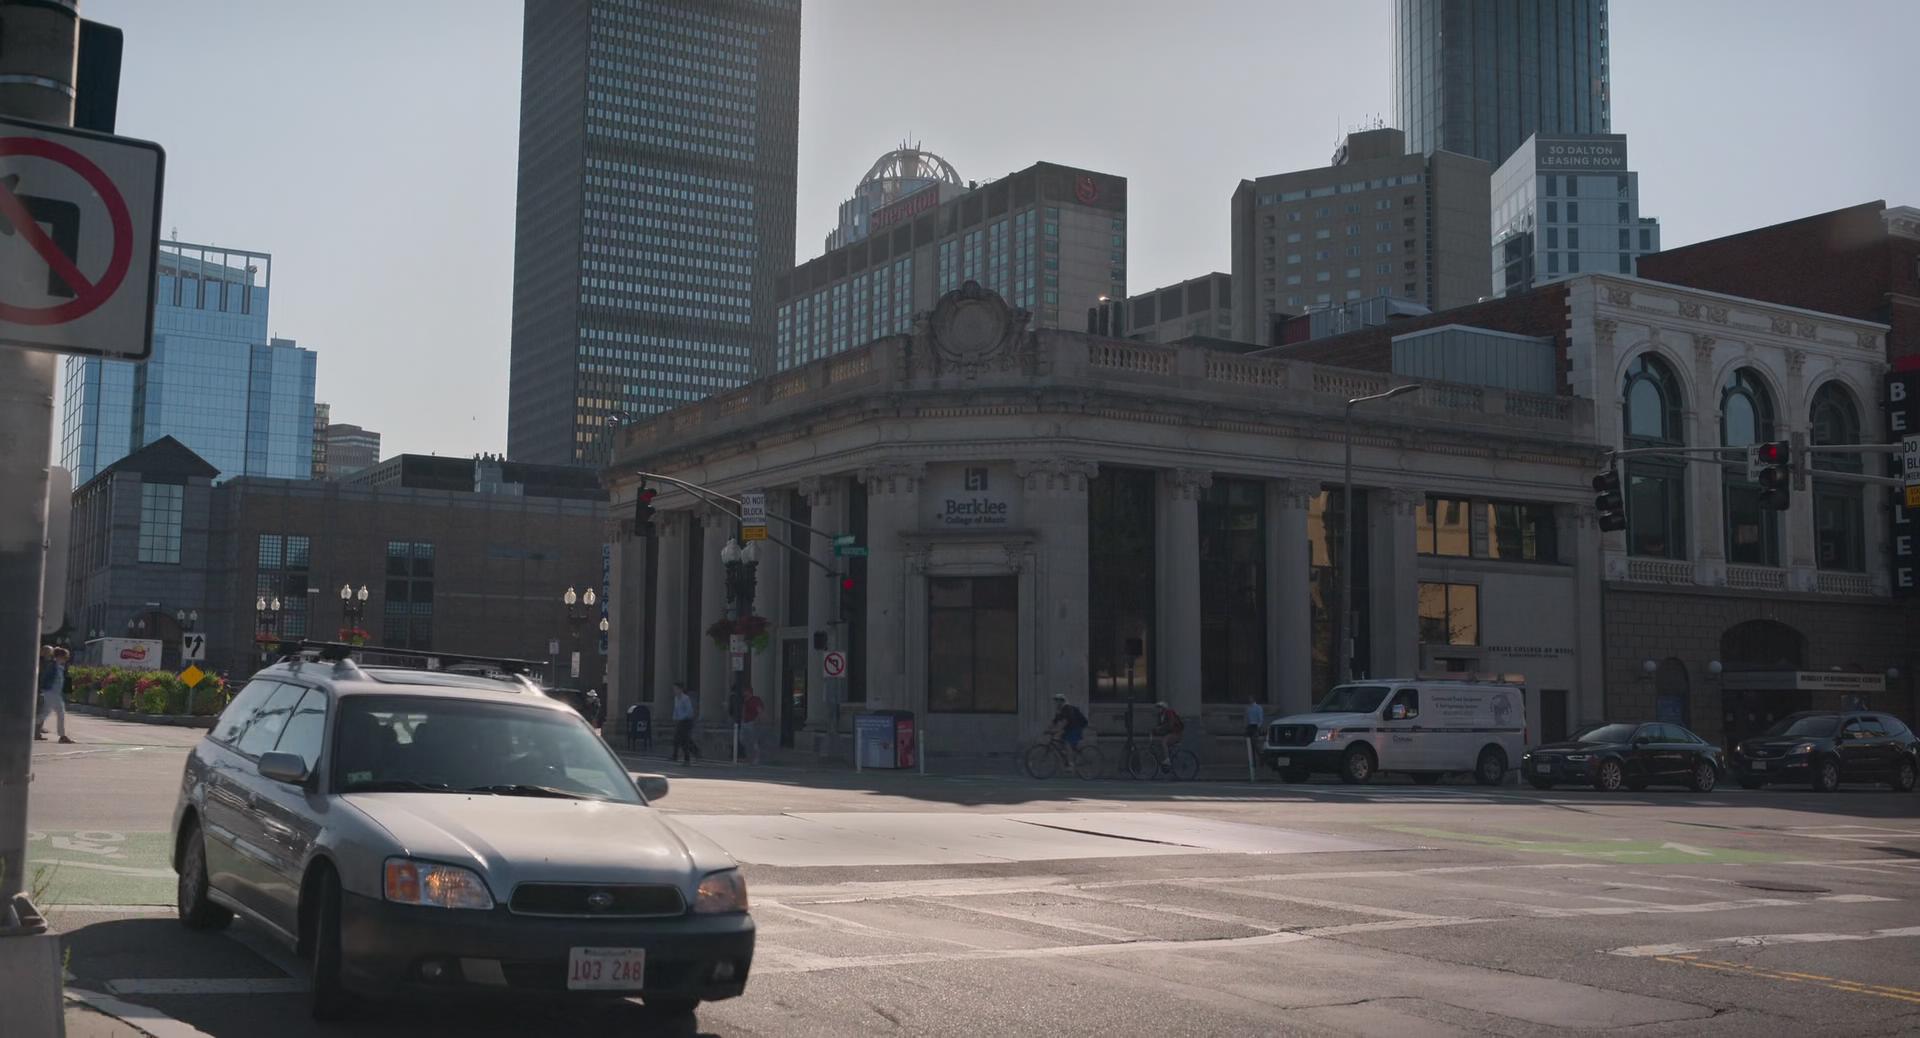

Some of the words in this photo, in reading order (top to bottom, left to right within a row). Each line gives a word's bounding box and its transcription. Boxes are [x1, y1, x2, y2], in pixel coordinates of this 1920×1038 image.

[1549, 146, 1564, 154] 30
[1567, 146, 1612, 155] DALTON
[1542, 157, 1589, 165] LEASING
[1593, 157, 1621, 166] NOW
[871, 191, 938, 230] Sheraton
[1904, 441, 1918, 454] DO
[945, 498, 1008, 515] Berklee
[945, 516, 973, 525] College
[975, 516, 983, 524] of
[571, 960, 602, 981] 103
